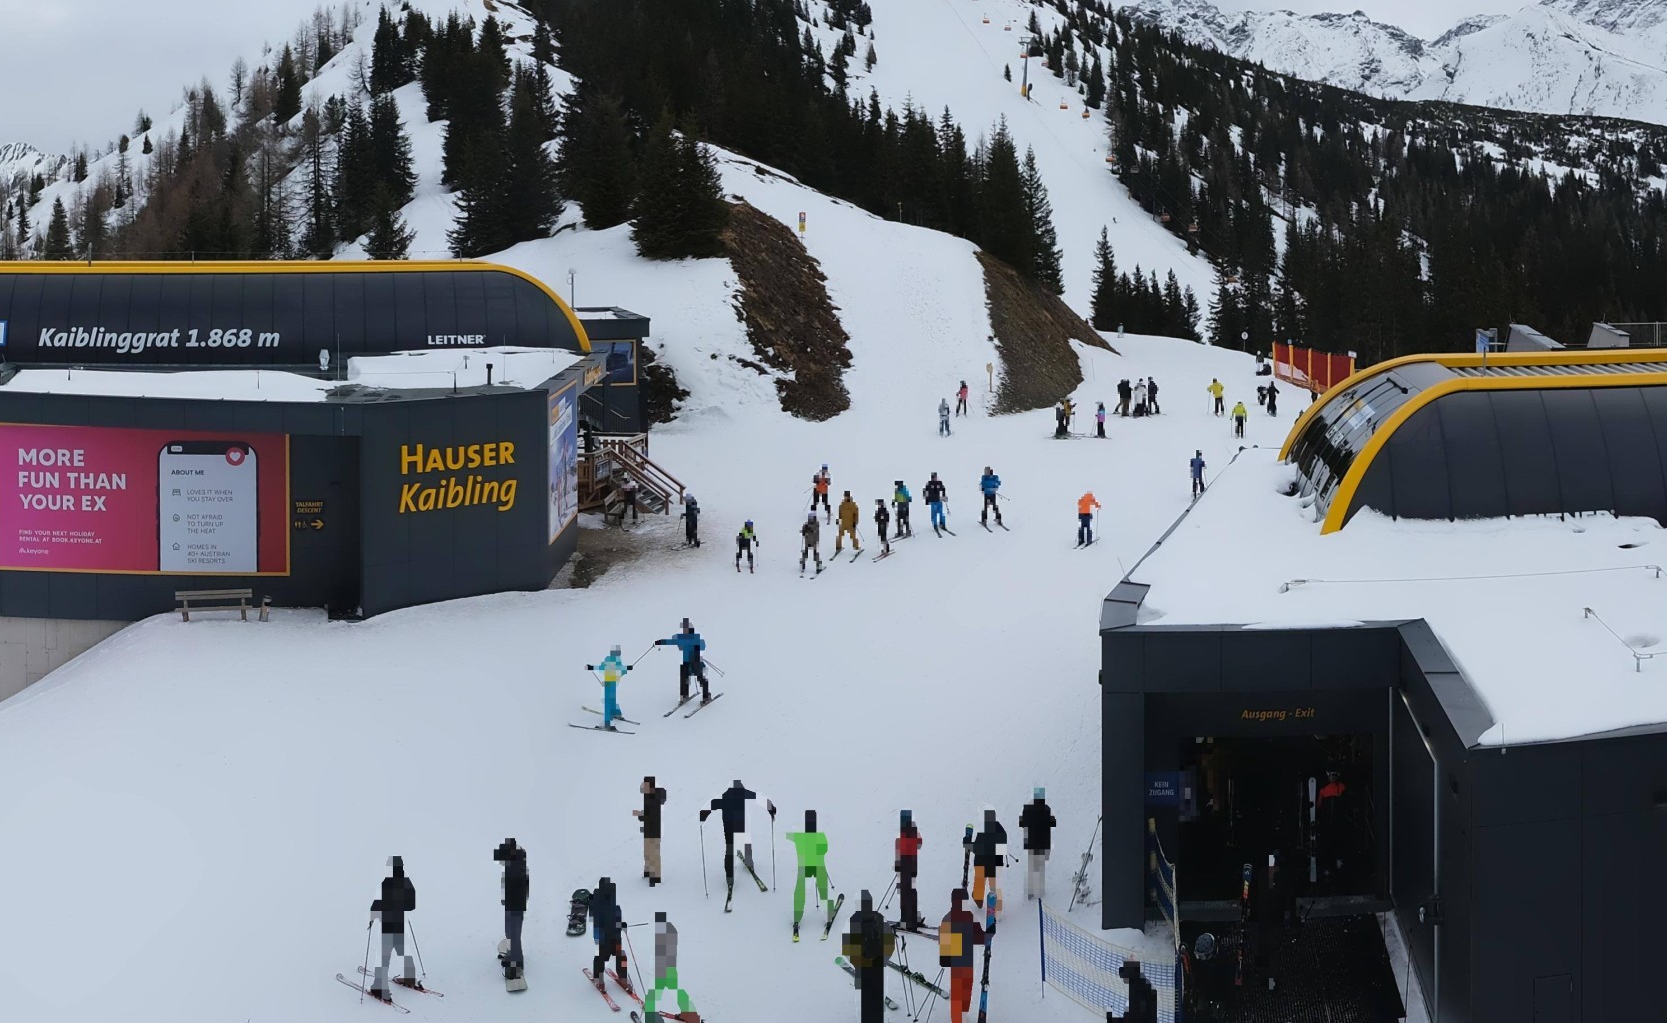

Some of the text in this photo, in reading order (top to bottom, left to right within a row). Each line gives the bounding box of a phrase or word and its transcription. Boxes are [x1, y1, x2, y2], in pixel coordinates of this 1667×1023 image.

[38, 327, 280, 354] Kaiblinggrat 1.868 m
[427, 335, 484, 345] LEITNER
[18, 448, 85, 467] MORE
[401, 441, 516, 475] HAUSER
[18, 471, 127, 490] FUN THAN
[19, 493, 107, 511] YOUR EX
[399, 475, 518, 514] Kaibling
[1241, 709, 1286, 721] Ausgang
[1295, 707, 1315, 718] Exit
